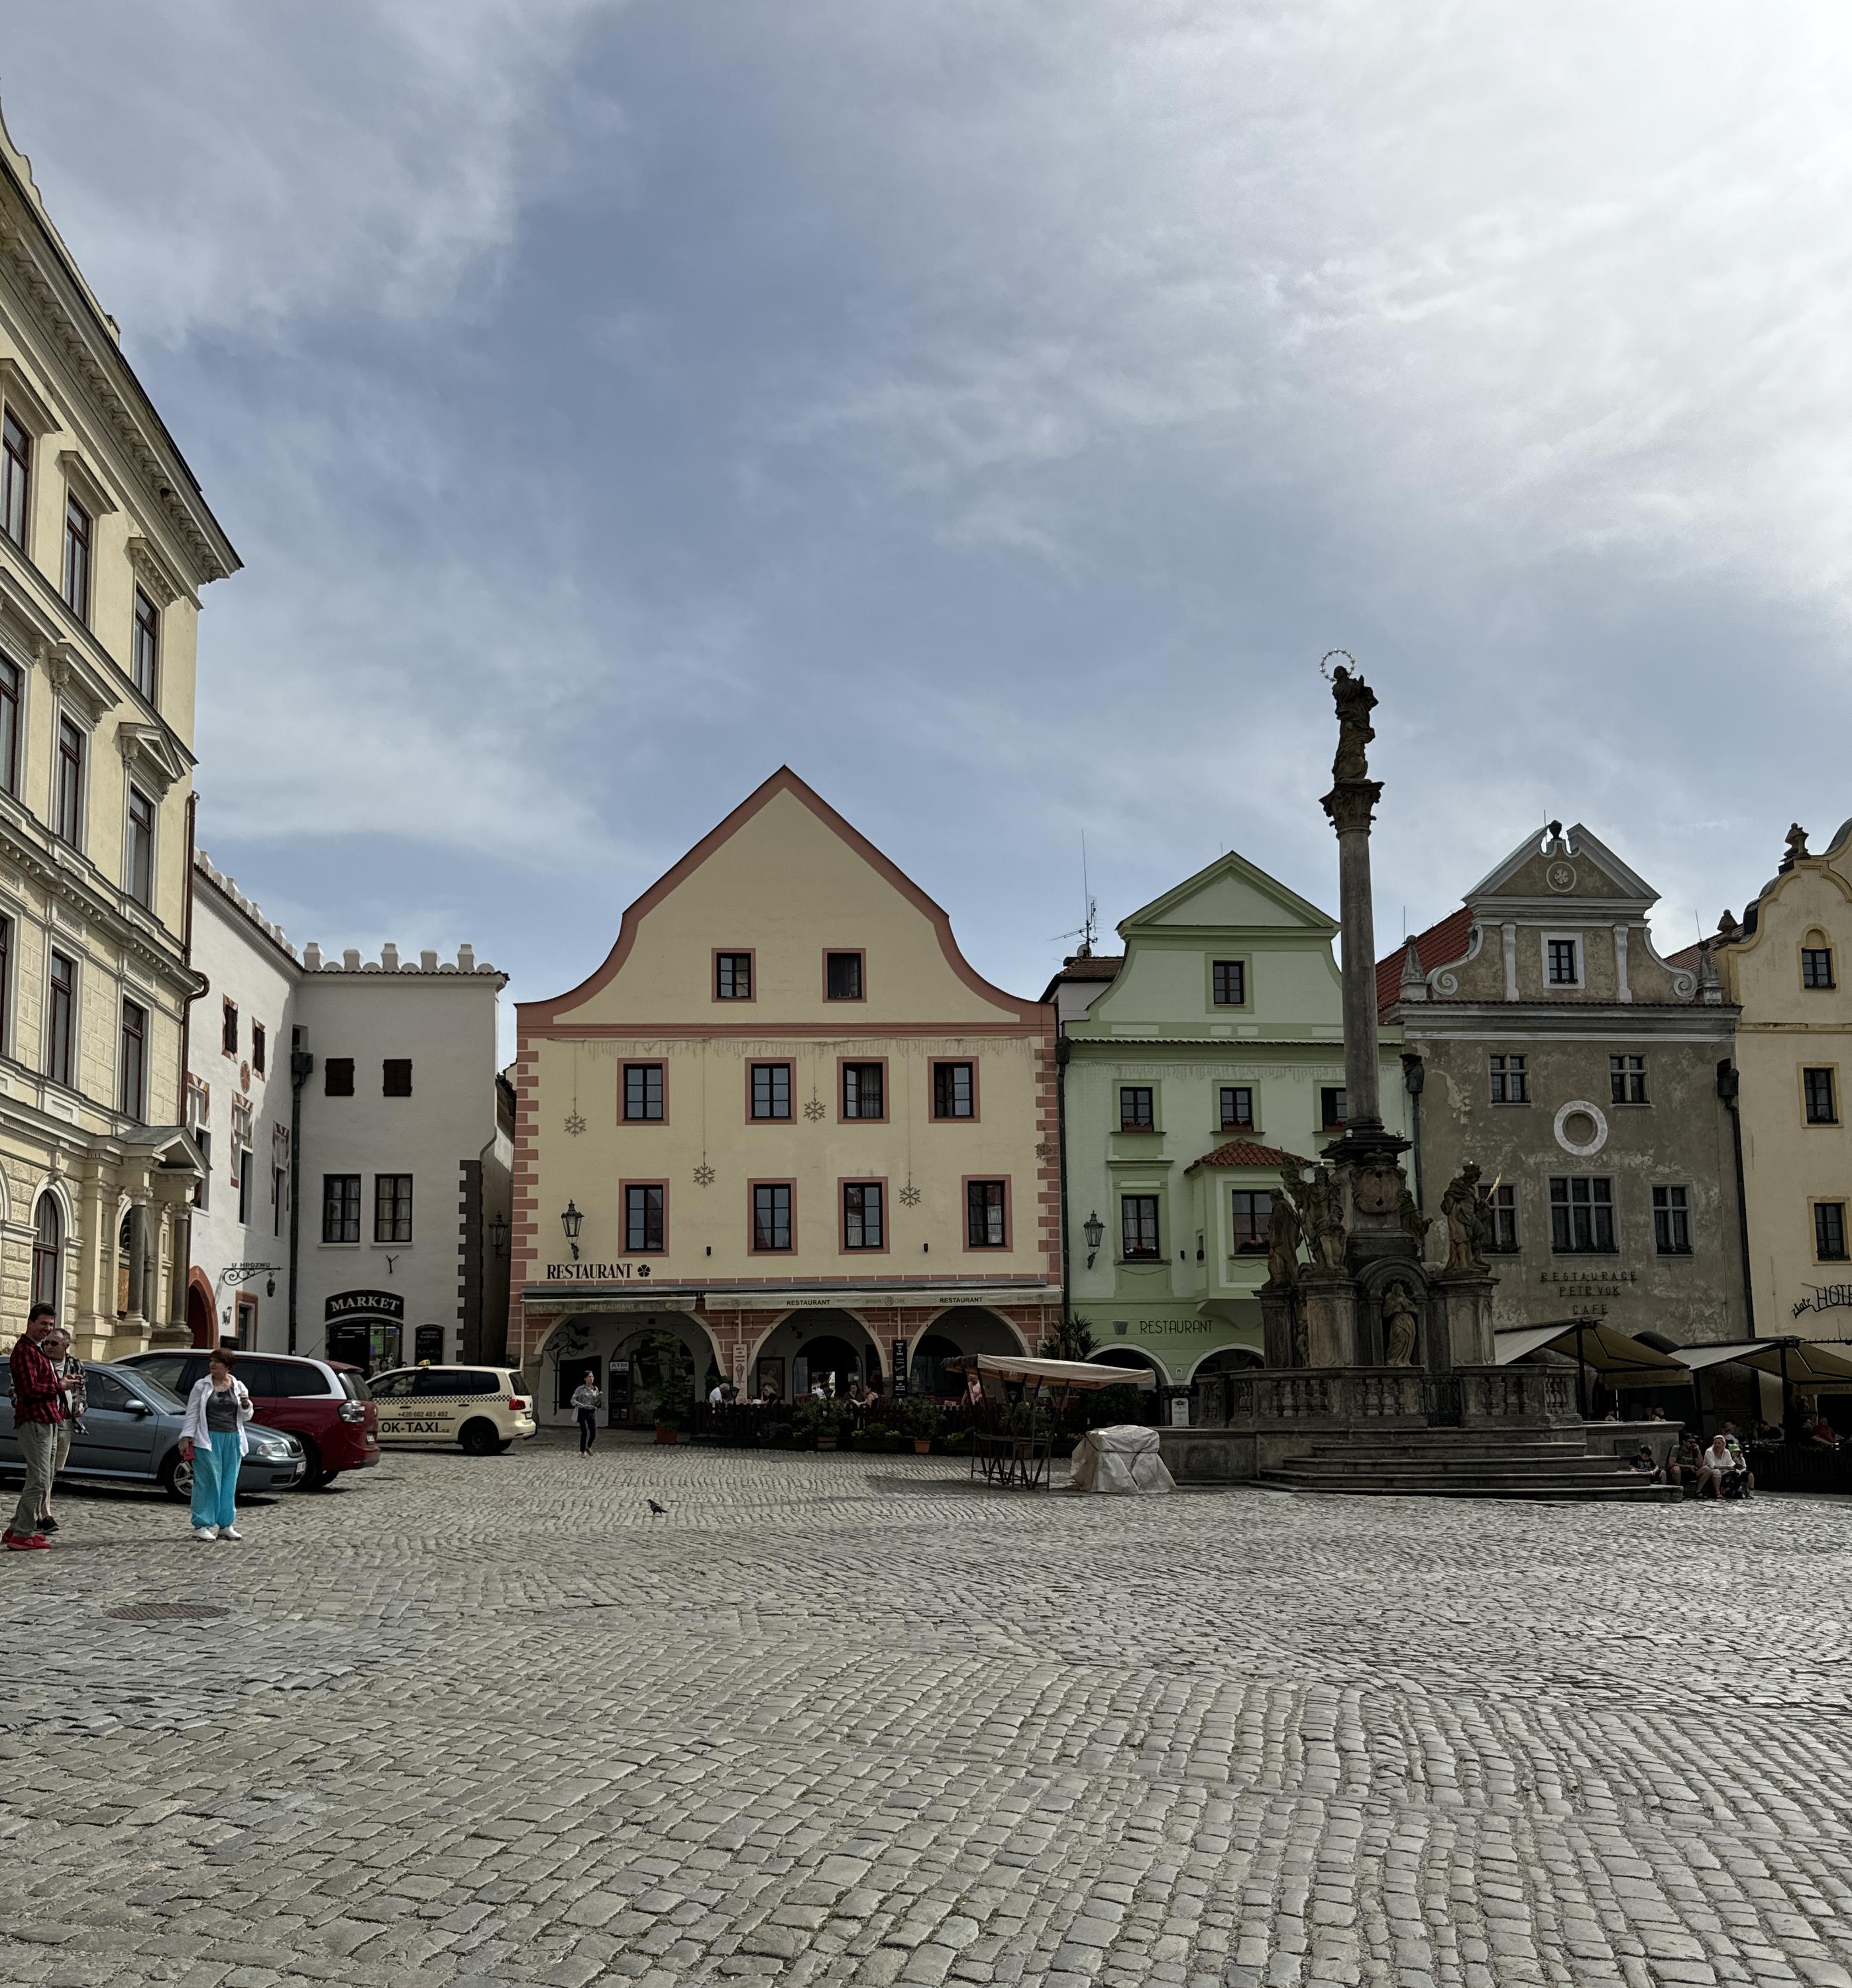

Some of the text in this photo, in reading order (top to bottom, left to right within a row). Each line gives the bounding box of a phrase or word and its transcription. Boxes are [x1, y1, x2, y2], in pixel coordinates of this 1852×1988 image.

[546, 1263, 633, 1279] RESTAURANT
[1541, 1271, 1637, 1282] RESTAURACE
[1598, 1286, 1621, 1296] VOK
[331, 1296, 400, 1311] MARKET
[1573, 1304, 1608, 1314] CAFE
[1140, 1320, 1213, 1333] RESTAURANT
